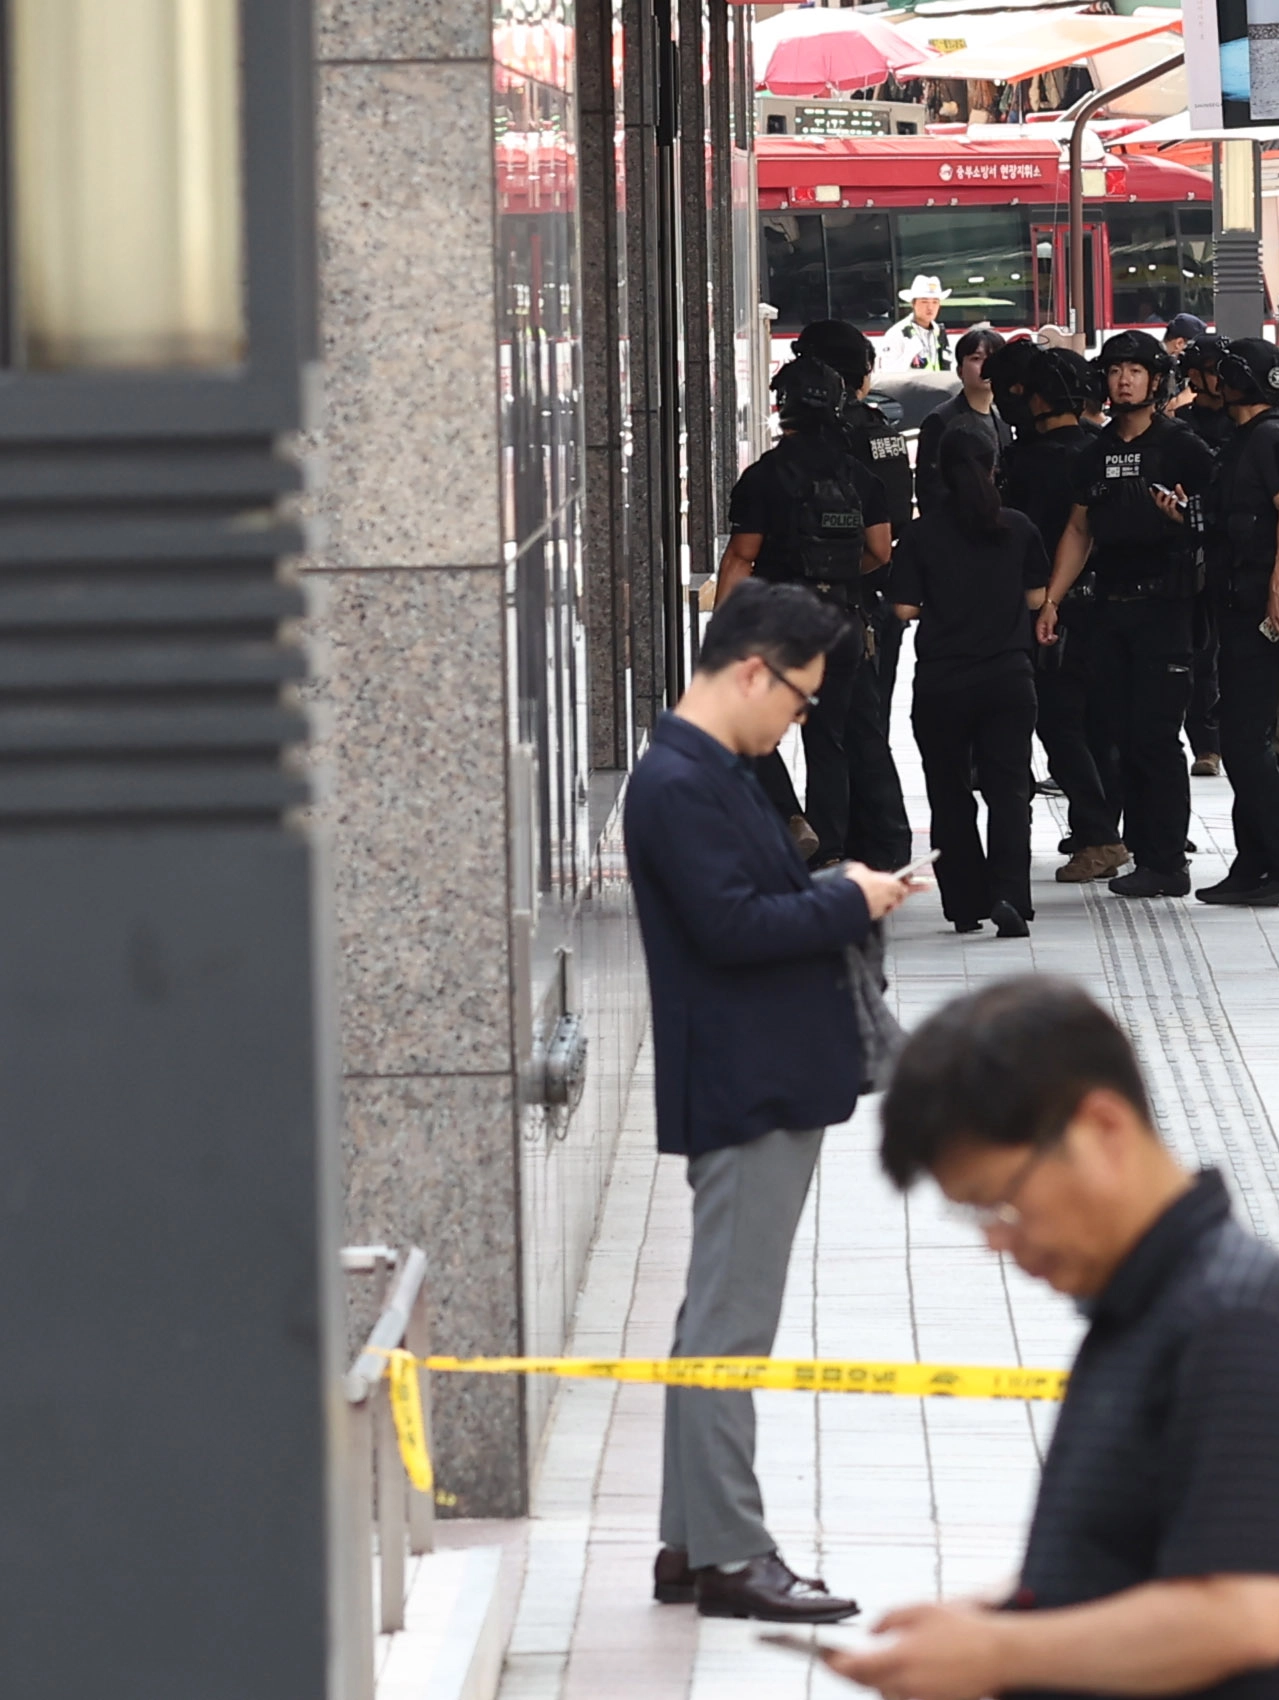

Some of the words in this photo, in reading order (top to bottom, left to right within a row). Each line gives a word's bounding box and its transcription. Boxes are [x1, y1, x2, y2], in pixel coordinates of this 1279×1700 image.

[956, 164, 998, 180] 중부소방서
[1000, 164, 1042, 180] 현장지휘소
[1105, 453, 1141, 465] POLICE
[823, 514, 861, 527] POLICE
